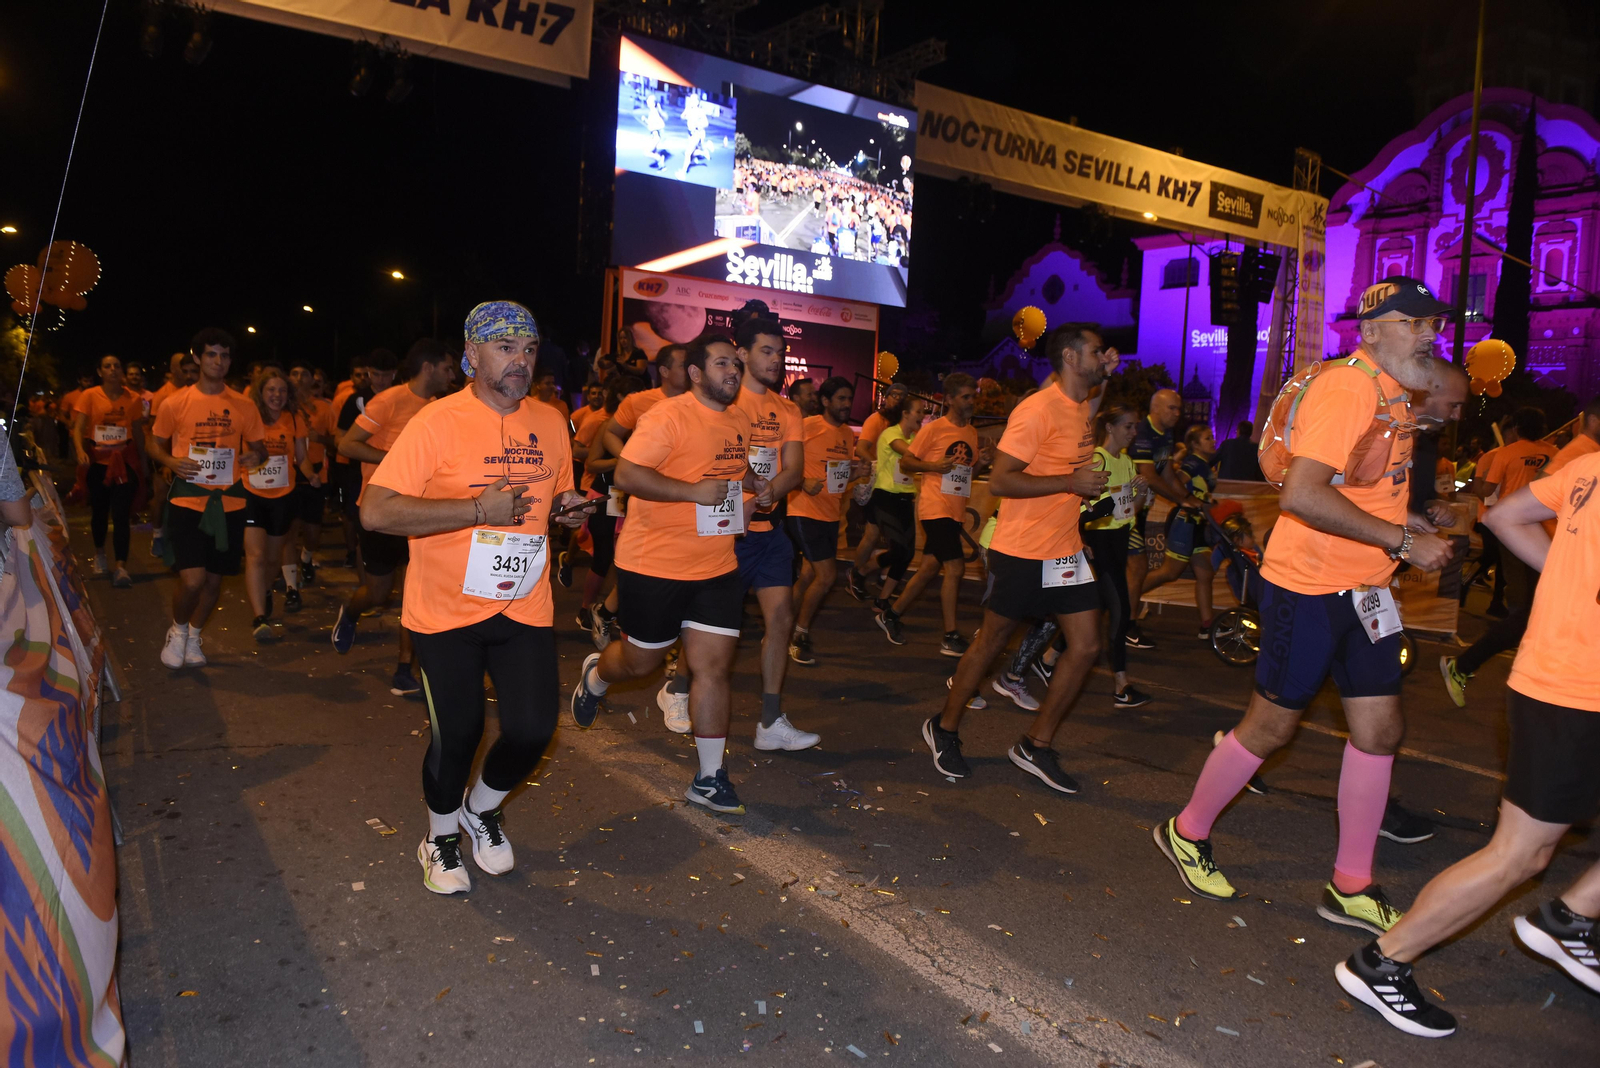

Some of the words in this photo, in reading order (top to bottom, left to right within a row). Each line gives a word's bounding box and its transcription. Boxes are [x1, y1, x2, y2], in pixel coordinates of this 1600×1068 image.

[919, 110, 1057, 169] NOCTURNA
[1063, 149, 1151, 194] SEVILLA
[676, 286, 691, 295] ABC
[698, 290, 729, 301] Cruzcampo
[504, 448, 544, 457] NOCTURNA
[200, 459, 226, 471] 20133
[484, 456, 524, 465] SEVILLA
[751, 462, 772, 474] 7229
[492, 554, 528, 573] 3431
